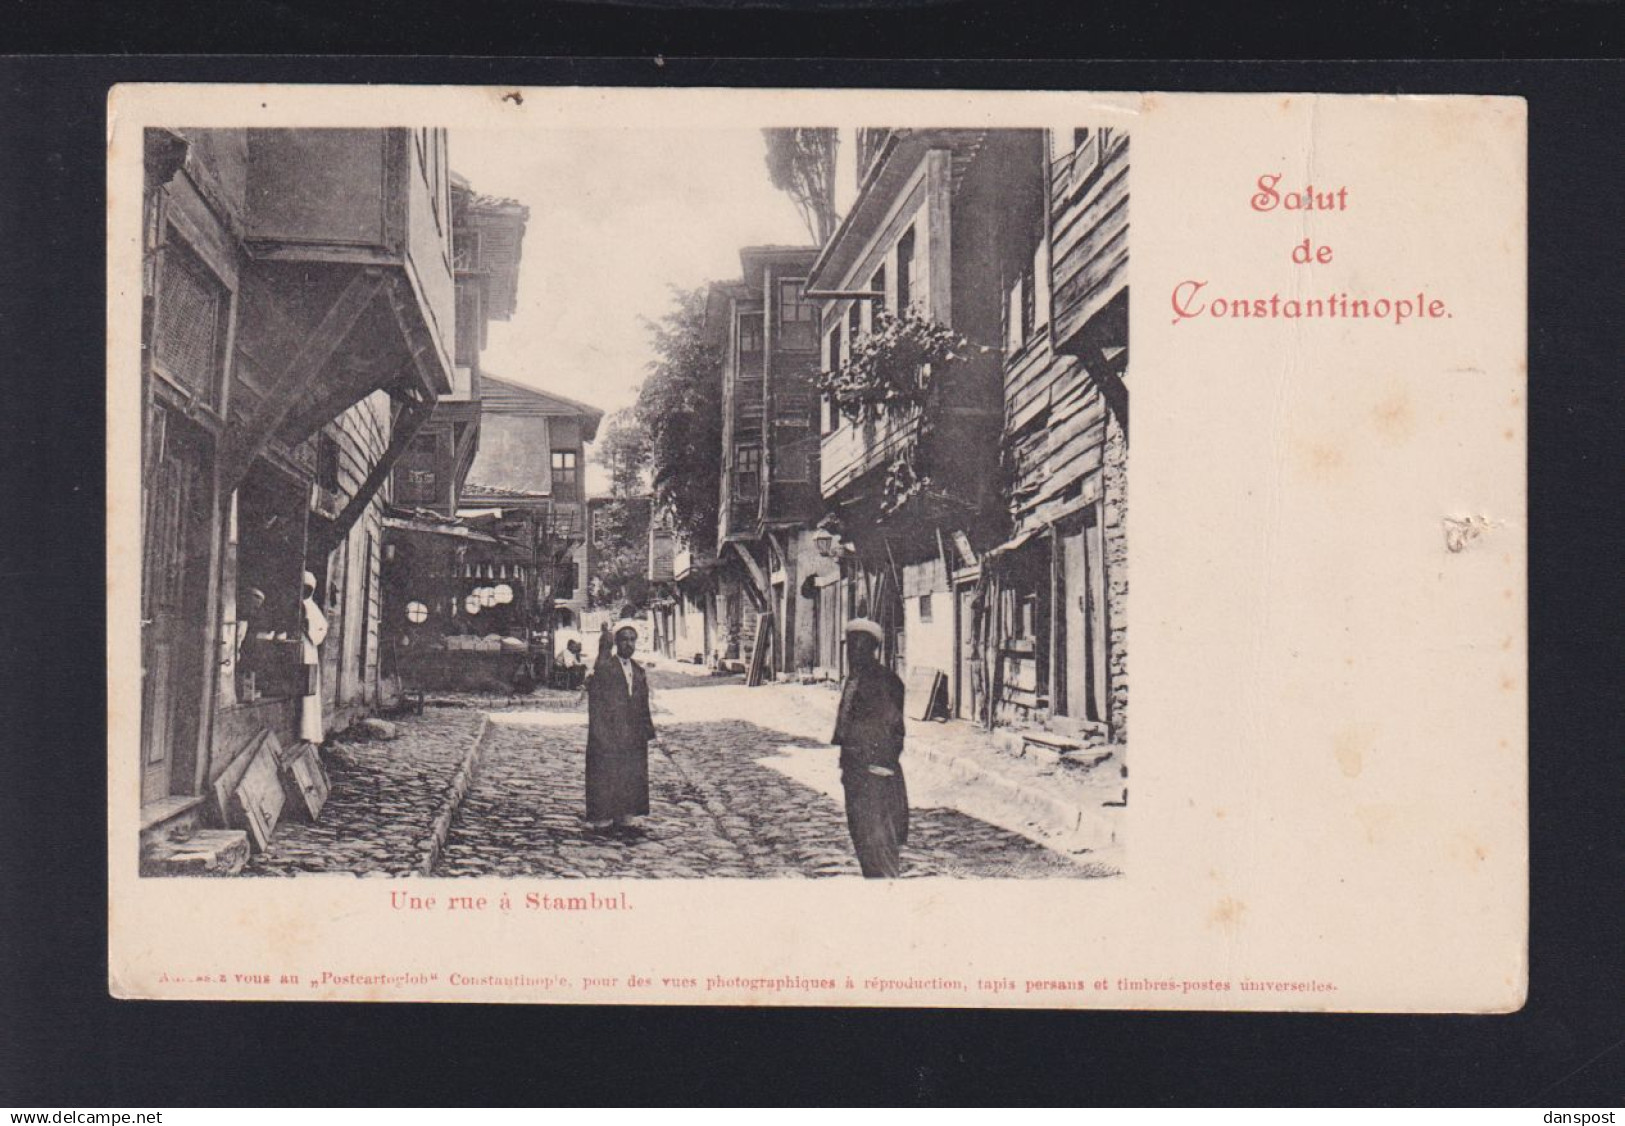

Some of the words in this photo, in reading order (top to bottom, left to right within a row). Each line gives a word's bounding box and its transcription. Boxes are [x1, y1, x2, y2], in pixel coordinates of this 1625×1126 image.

[1249, 172, 1350, 213] Salut
[1290, 237, 1334, 267] de
[1170, 279, 1454, 329] Constantinople.
[389, 890, 437, 911] Une
[447, 896, 488, 911] rue
[525, 891, 635, 912] Stambul.
[234, 973, 272, 985] vous
[279, 974, 300, 986] au
[582, 976, 620, 991] pour
[627, 974, 652, 988] des
[661, 976, 697, 988] vues
[706, 974, 837, 991] photographiques
[977, 979, 1018, 993] tapis
[1025, 981, 1086, 993] persans
[1093, 979, 1109, 991] et
[1116, 979, 1231, 994] timbres-postes
